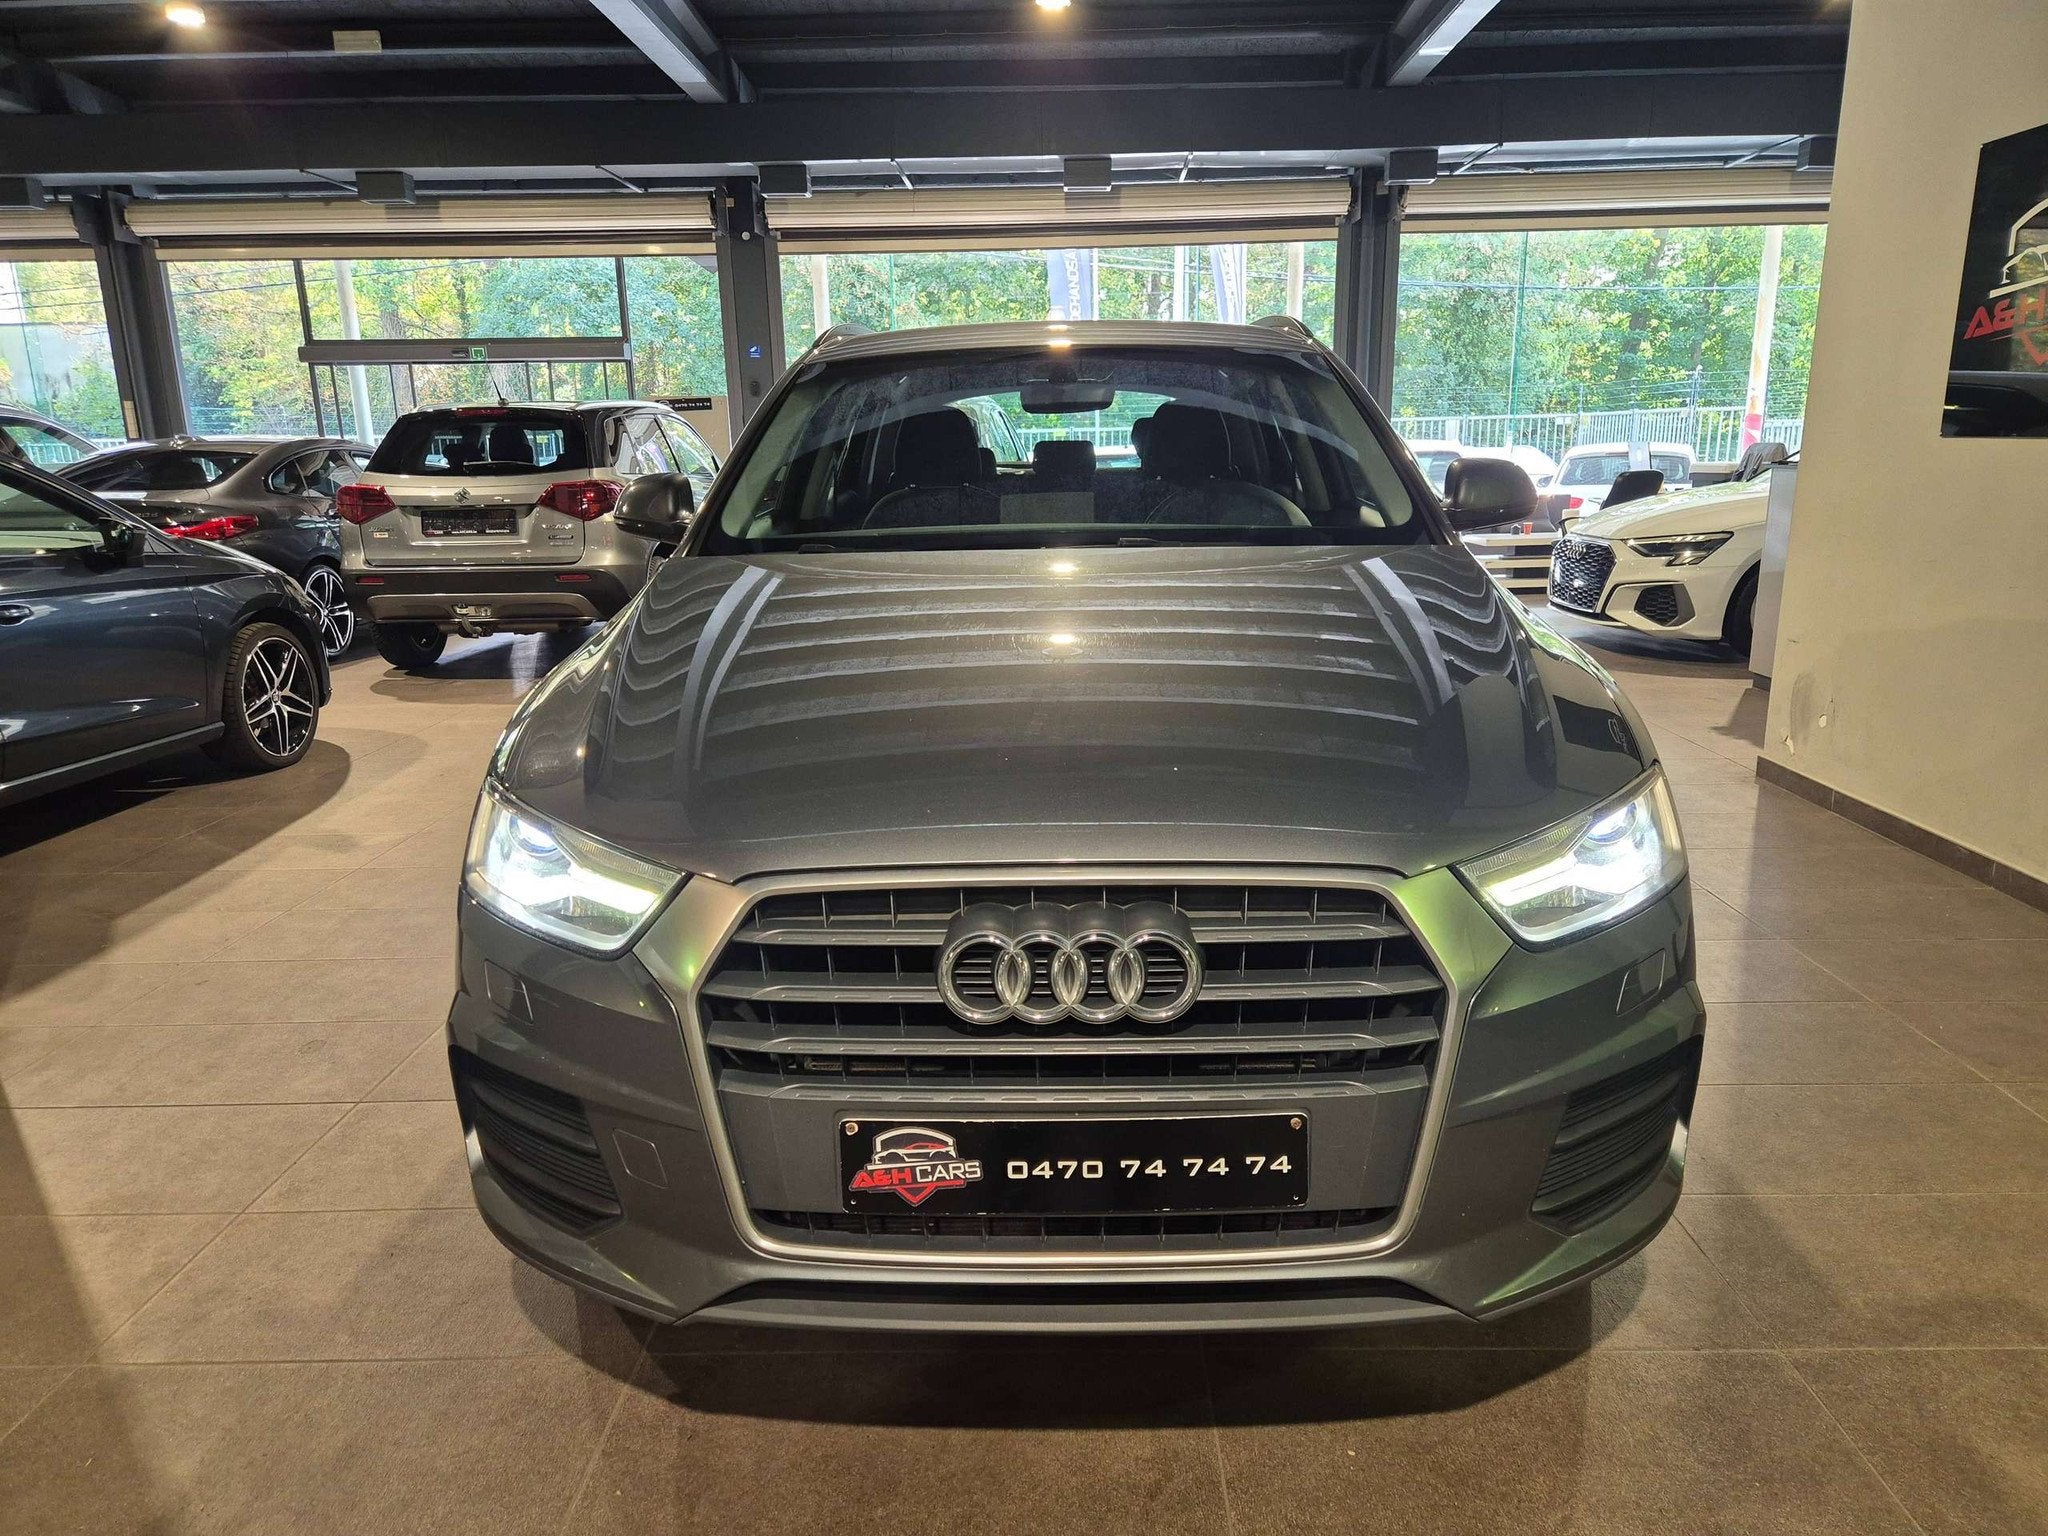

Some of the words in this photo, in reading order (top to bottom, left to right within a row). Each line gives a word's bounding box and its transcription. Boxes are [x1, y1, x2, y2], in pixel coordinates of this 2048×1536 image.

[1963, 288, 2046, 340] A&H
[853, 1168, 912, 1187] A&H
[916, 1162, 981, 1182] CARS
[1007, 1160, 1104, 1179] 0470
[1120, 1159, 1167, 1178] 74
[1183, 1157, 1230, 1177] 74
[1245, 1155, 1292, 1175] 74
